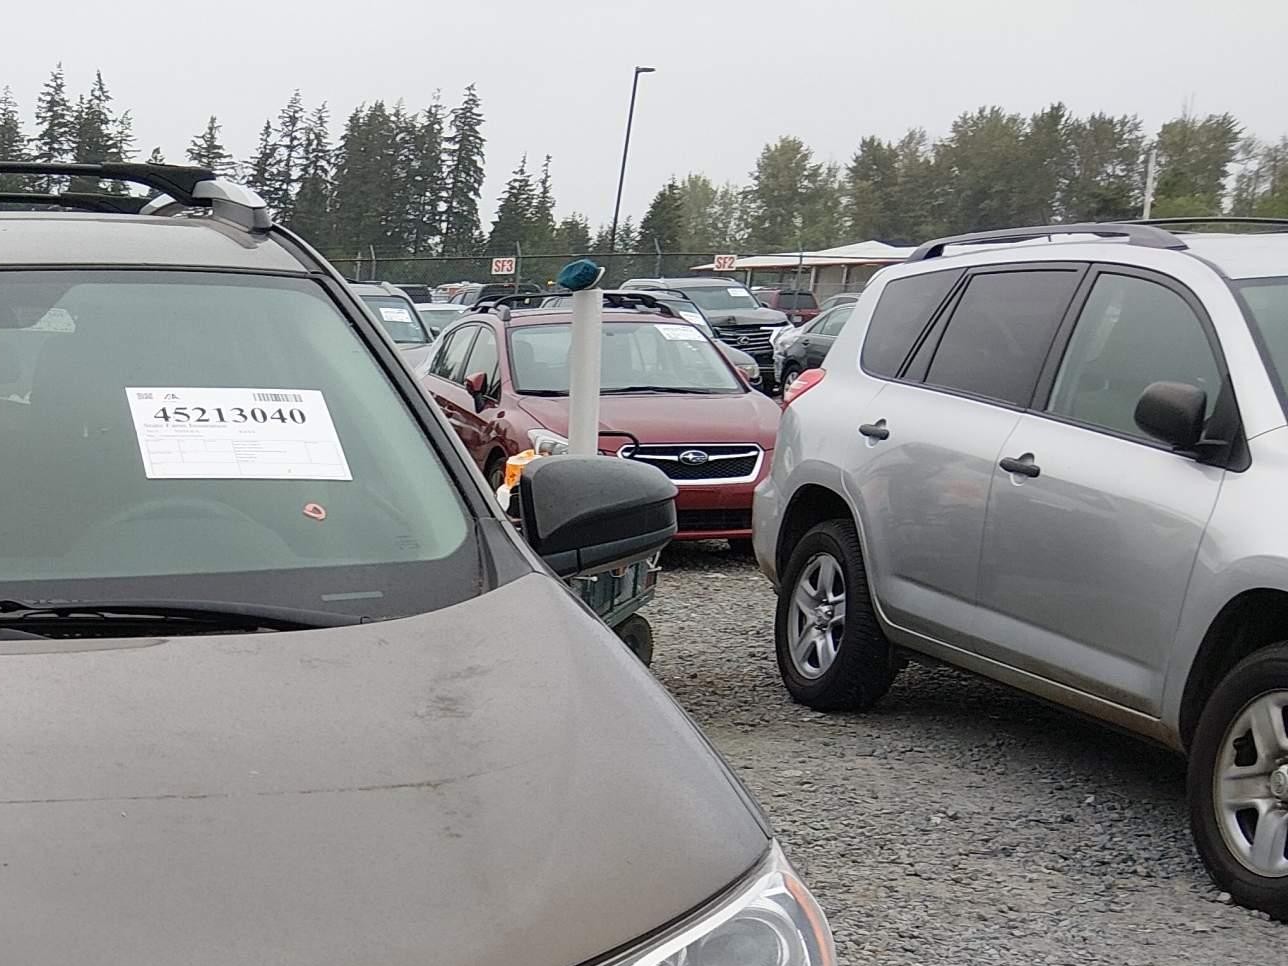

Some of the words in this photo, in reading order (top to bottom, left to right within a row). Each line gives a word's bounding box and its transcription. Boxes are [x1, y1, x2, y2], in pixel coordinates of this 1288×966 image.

[494, 260, 513, 272] SF3
[716, 257, 735, 269] SF2
[154, 407, 306, 424] 45213040
